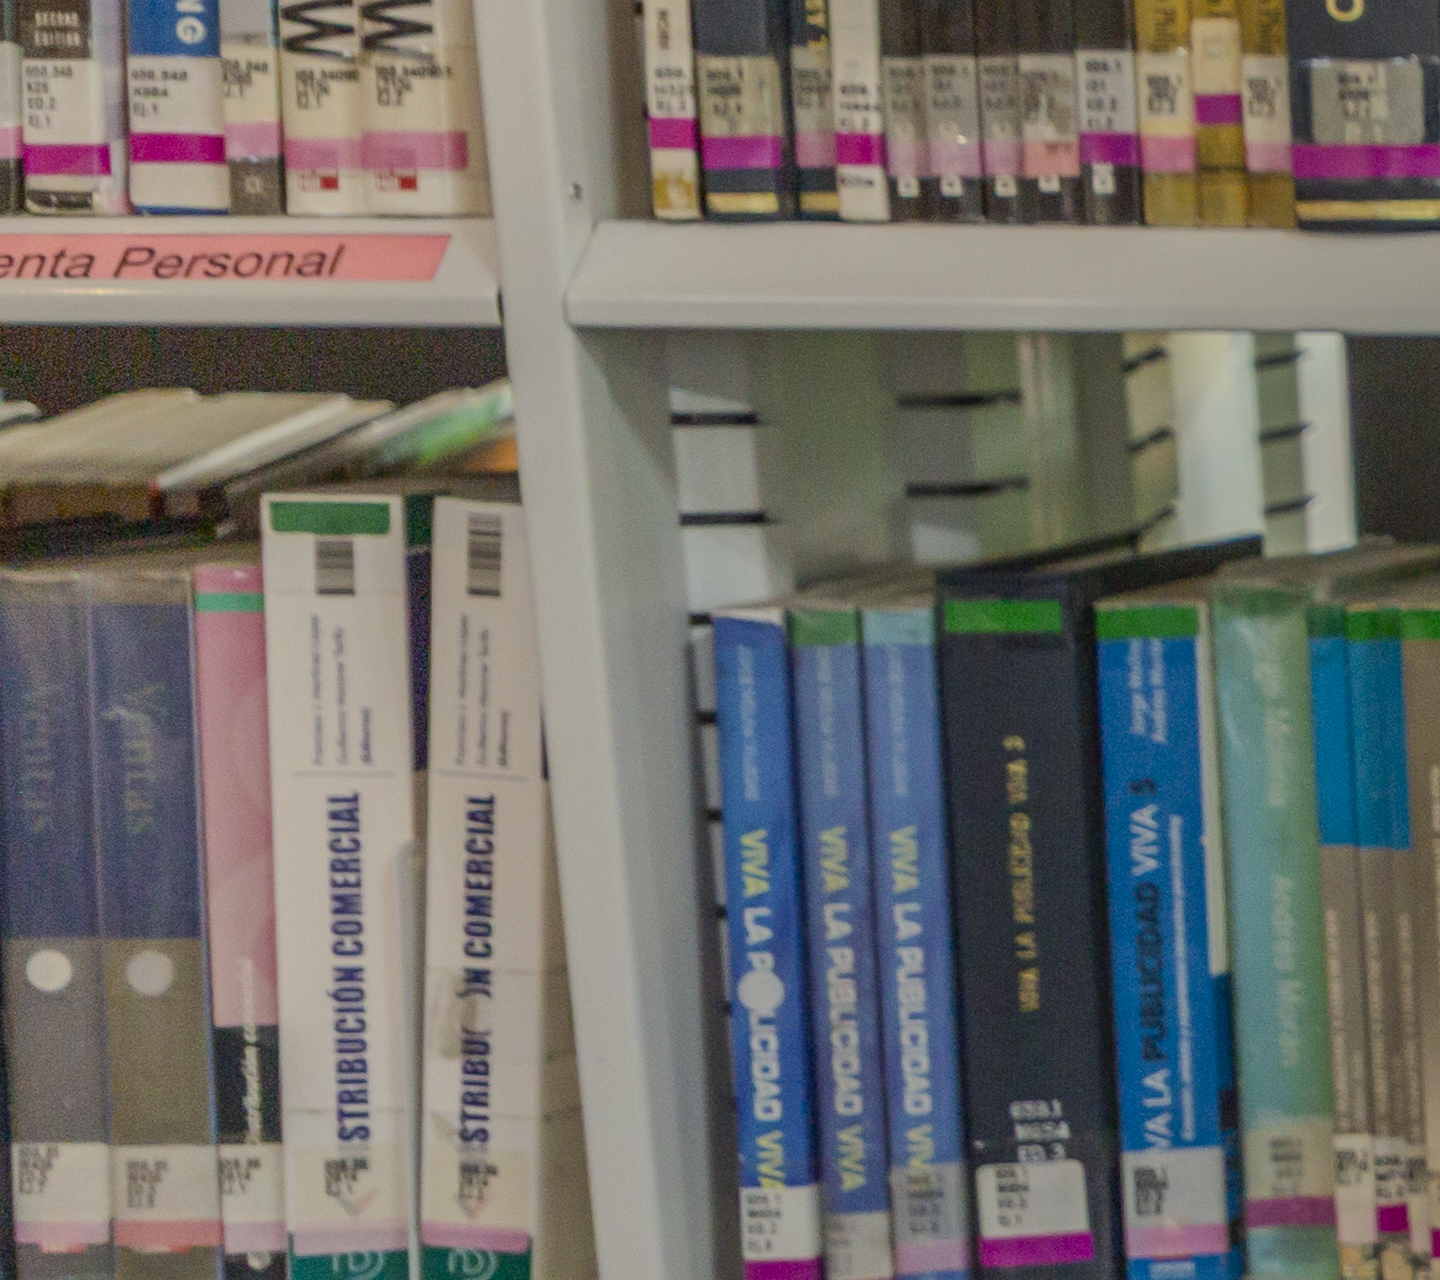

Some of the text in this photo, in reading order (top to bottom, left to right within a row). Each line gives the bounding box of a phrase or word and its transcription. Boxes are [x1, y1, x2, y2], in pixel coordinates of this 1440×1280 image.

[114, 244, 347, 280] Personal
[738, 829, 770, 898] VIVA
[818, 826, 850, 893] VIVA
[890, 826, 921, 894] VIVA
[1129, 805, 1161, 877] VIVA
[743, 906, 773, 945] LA
[822, 903, 853, 942] LA
[893, 903, 924, 943] LA
[327, 792, 371, 1144] STRIBUCIÓN COMERCIAL
[825, 947, 864, 1115] PUBLICIDAD
[896, 947, 934, 1114] PUBLICIDAD
